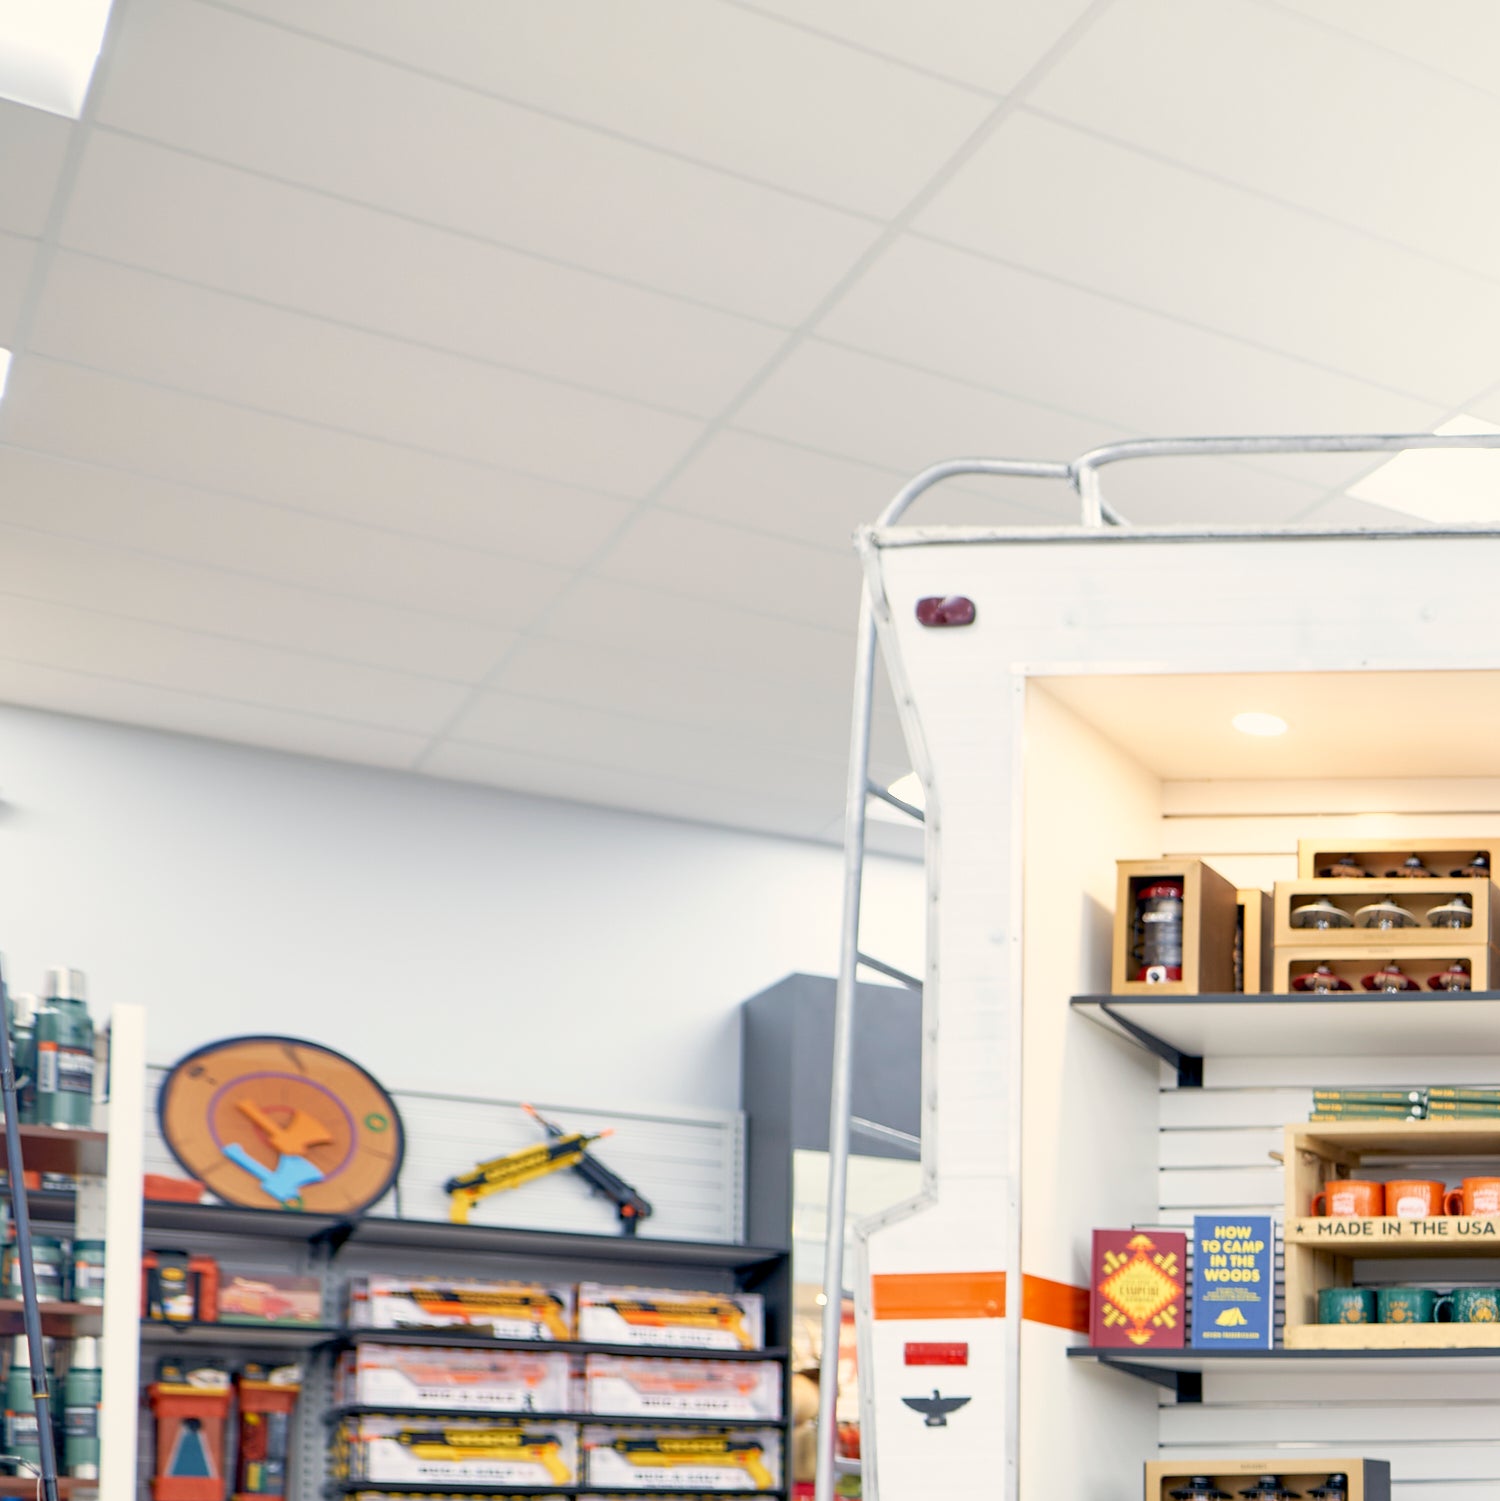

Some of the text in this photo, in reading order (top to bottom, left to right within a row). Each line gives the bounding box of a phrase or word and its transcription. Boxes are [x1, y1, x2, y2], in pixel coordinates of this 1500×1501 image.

[1215, 1226, 1252, 1239] HOW
[1317, 1221, 1496, 1236] MADE IN THE USA
[1202, 1240, 1264, 1254] TO CAMP
[1210, 1255, 1255, 1268] IN THE
[1204, 1269, 1261, 1282] WOODS
